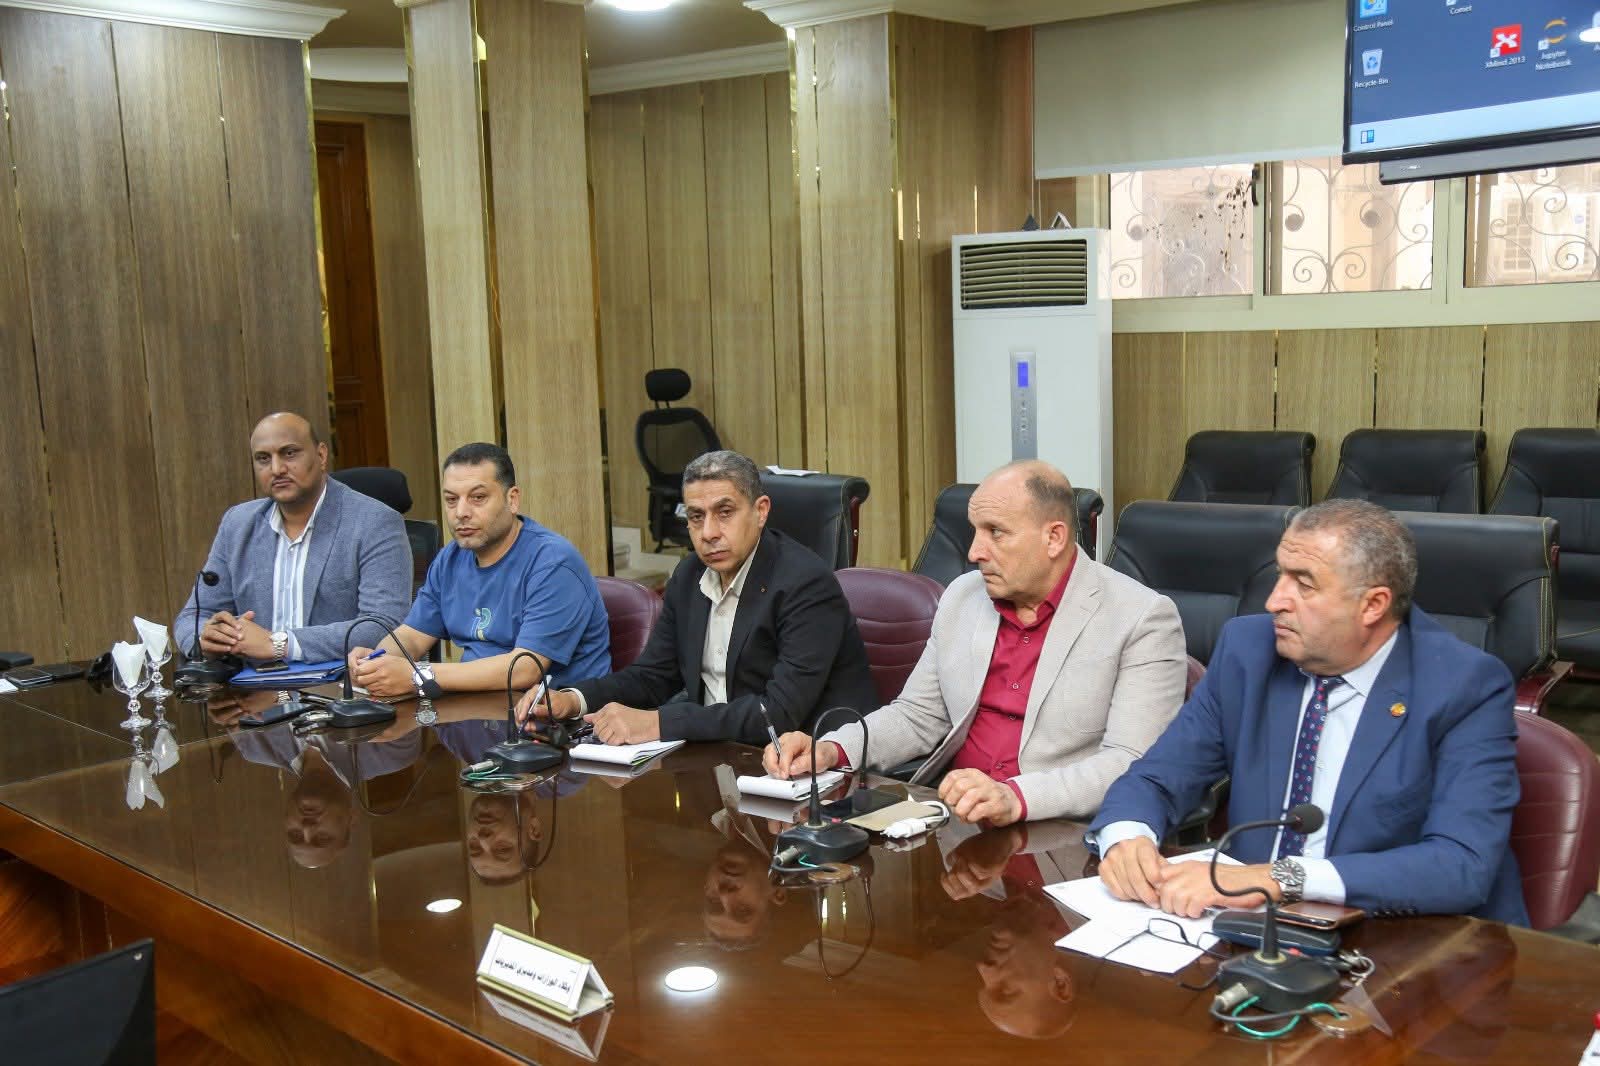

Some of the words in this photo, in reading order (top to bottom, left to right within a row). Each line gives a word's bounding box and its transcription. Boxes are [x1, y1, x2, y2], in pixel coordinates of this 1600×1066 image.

[1353, 23, 1376, 32] Control
[1377, 19, 1394, 28] Panel
[1509, 56, 1526, 65] 2013
[1541, 51, 1567, 60] Jupyter
[1535, 59, 1573, 71] Notebook
[1354, 79, 1377, 89] Recycle
[1378, 78, 1389, 86] Bin
